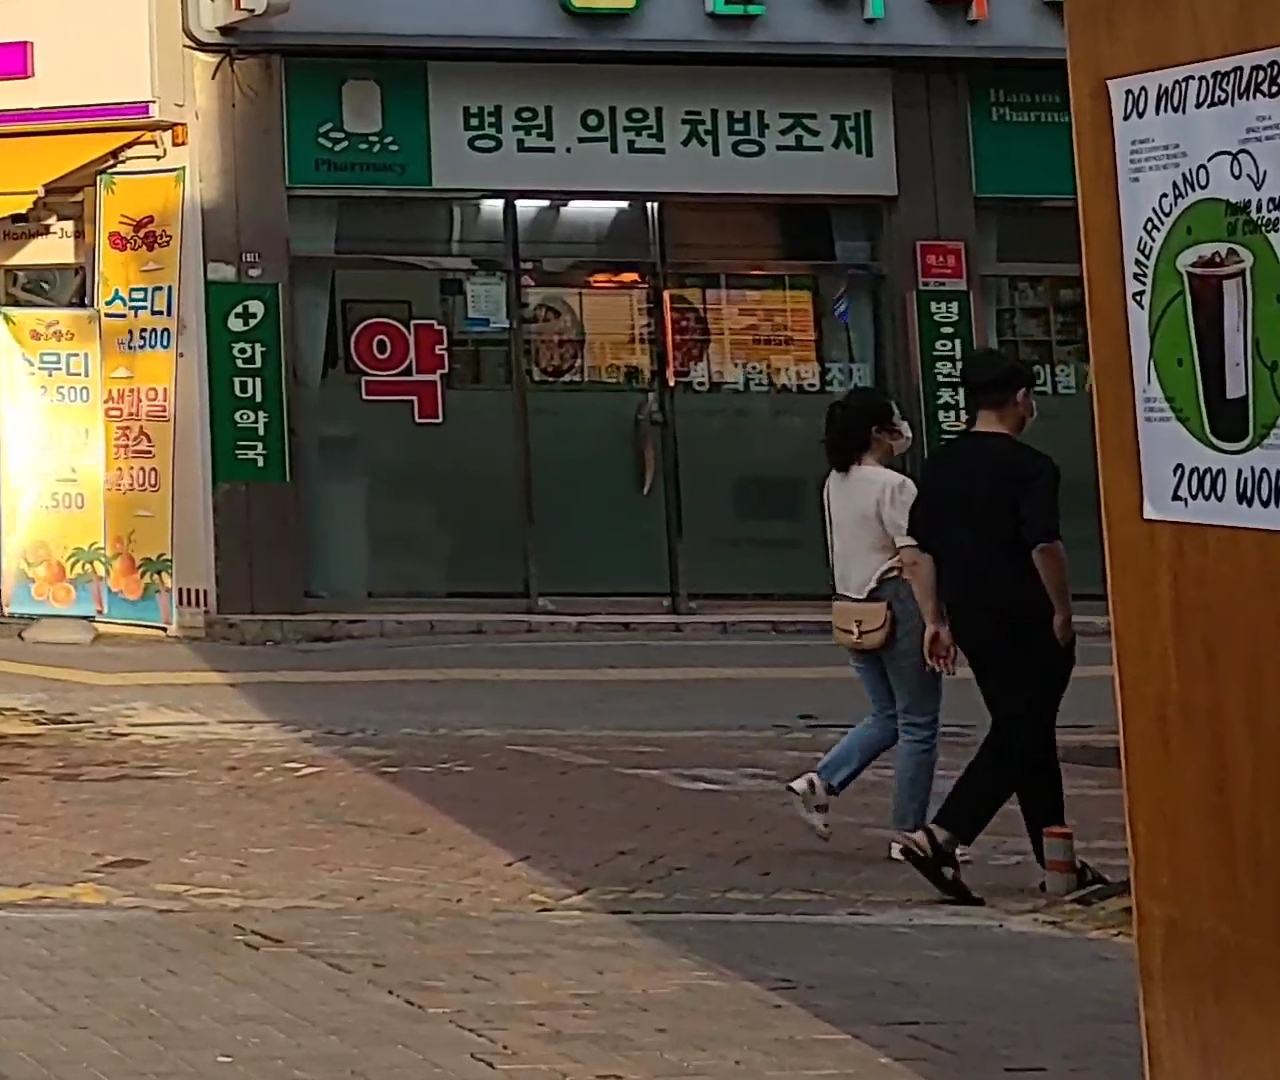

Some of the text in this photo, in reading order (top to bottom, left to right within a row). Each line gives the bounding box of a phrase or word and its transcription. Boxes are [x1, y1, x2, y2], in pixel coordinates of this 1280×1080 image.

[1123, 86, 1148, 122] DO
[680, 108, 874, 158] 처방조제
[314, 158, 407, 176] Pharmacy
[1131, 163, 1209, 310] AMERICANO
[104, 285, 172, 319] 스무디
[351, 317, 448, 424] 약
[103, 385, 170, 422] 생과일
[230, 341, 270, 468] 한미약국
[1171, 463, 1227, 508] 2,000
